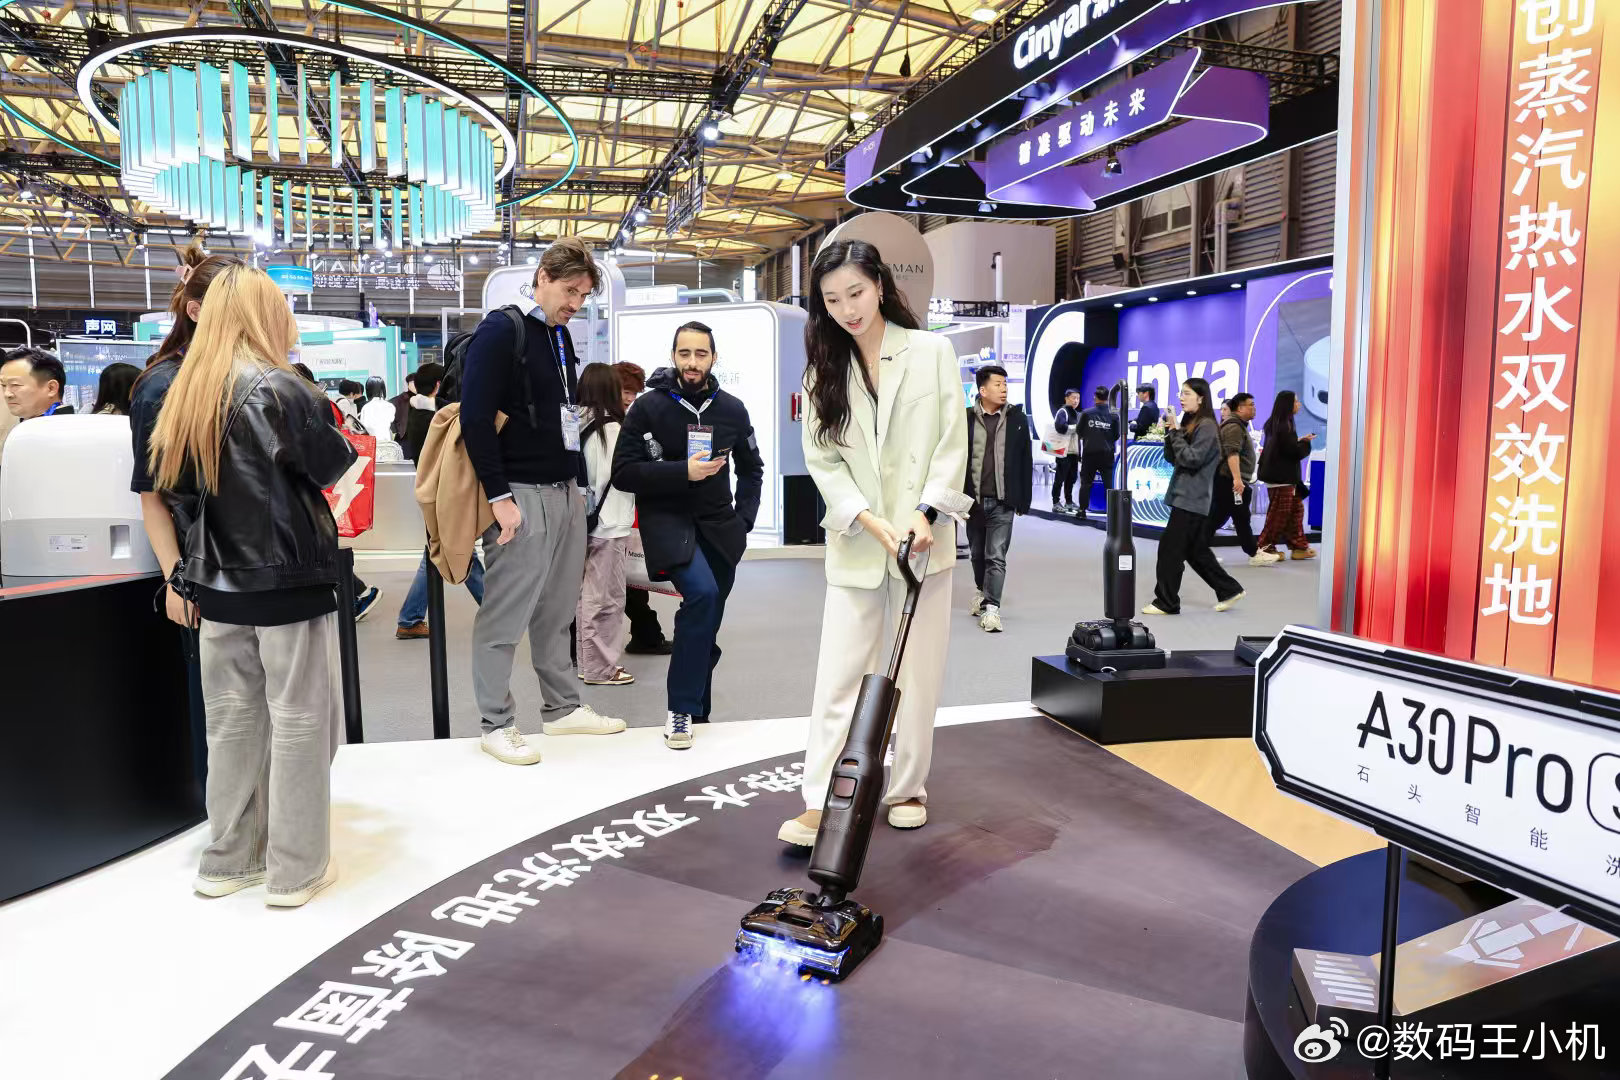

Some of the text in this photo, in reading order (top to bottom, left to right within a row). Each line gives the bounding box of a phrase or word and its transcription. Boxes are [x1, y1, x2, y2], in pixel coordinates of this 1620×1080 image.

[1013, 0, 1092, 69] Cinyar
[84, 319, 117, 335] 声网
[1481, 0, 1595, 627] 创蒸汽热水双效洗地
